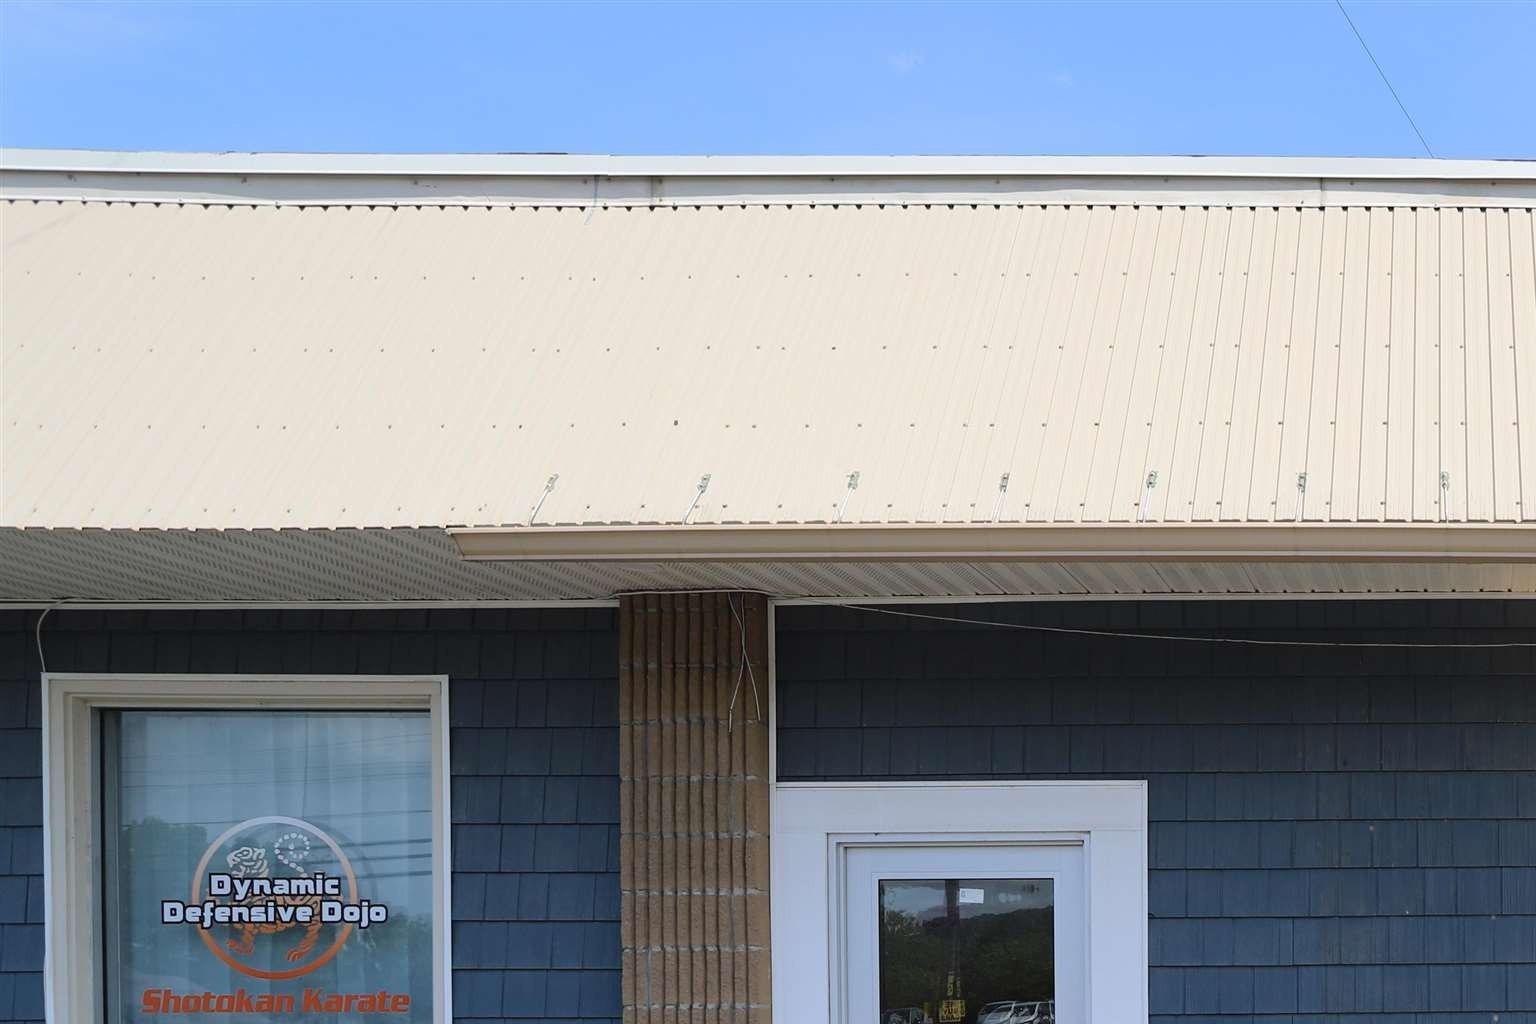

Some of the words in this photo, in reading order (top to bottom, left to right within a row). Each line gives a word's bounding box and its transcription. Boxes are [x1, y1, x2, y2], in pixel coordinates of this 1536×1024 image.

[209, 873, 341, 900] Dynamic
[161, 900, 313, 929] Defensive
[320, 900, 388, 928] Dojo
[141, 988, 294, 1014] Shotokan
[302, 988, 411, 1014] Karate
